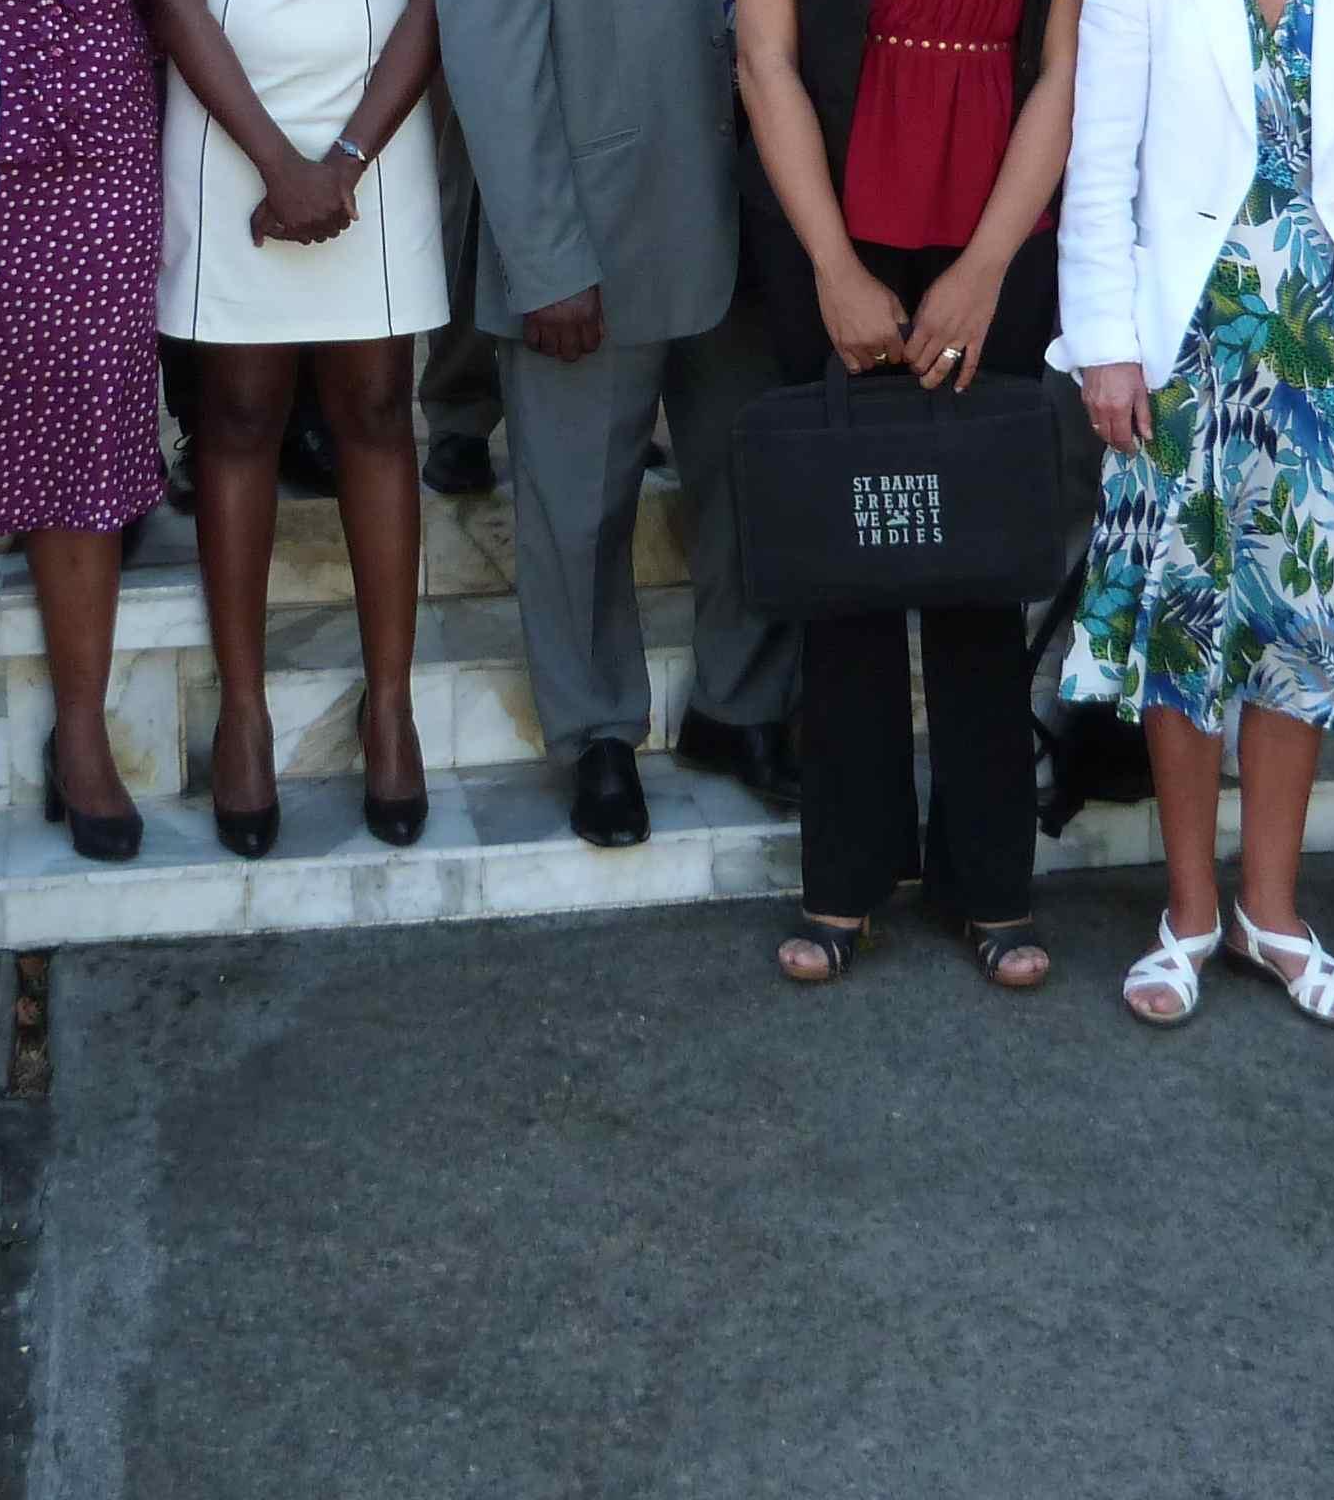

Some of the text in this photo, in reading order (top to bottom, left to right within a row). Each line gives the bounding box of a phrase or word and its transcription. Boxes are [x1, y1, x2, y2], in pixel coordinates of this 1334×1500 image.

[852, 474, 939, 492] ST BARTH
[854, 491, 940, 510] FRENCH
[858, 527, 943, 547] INDIES
